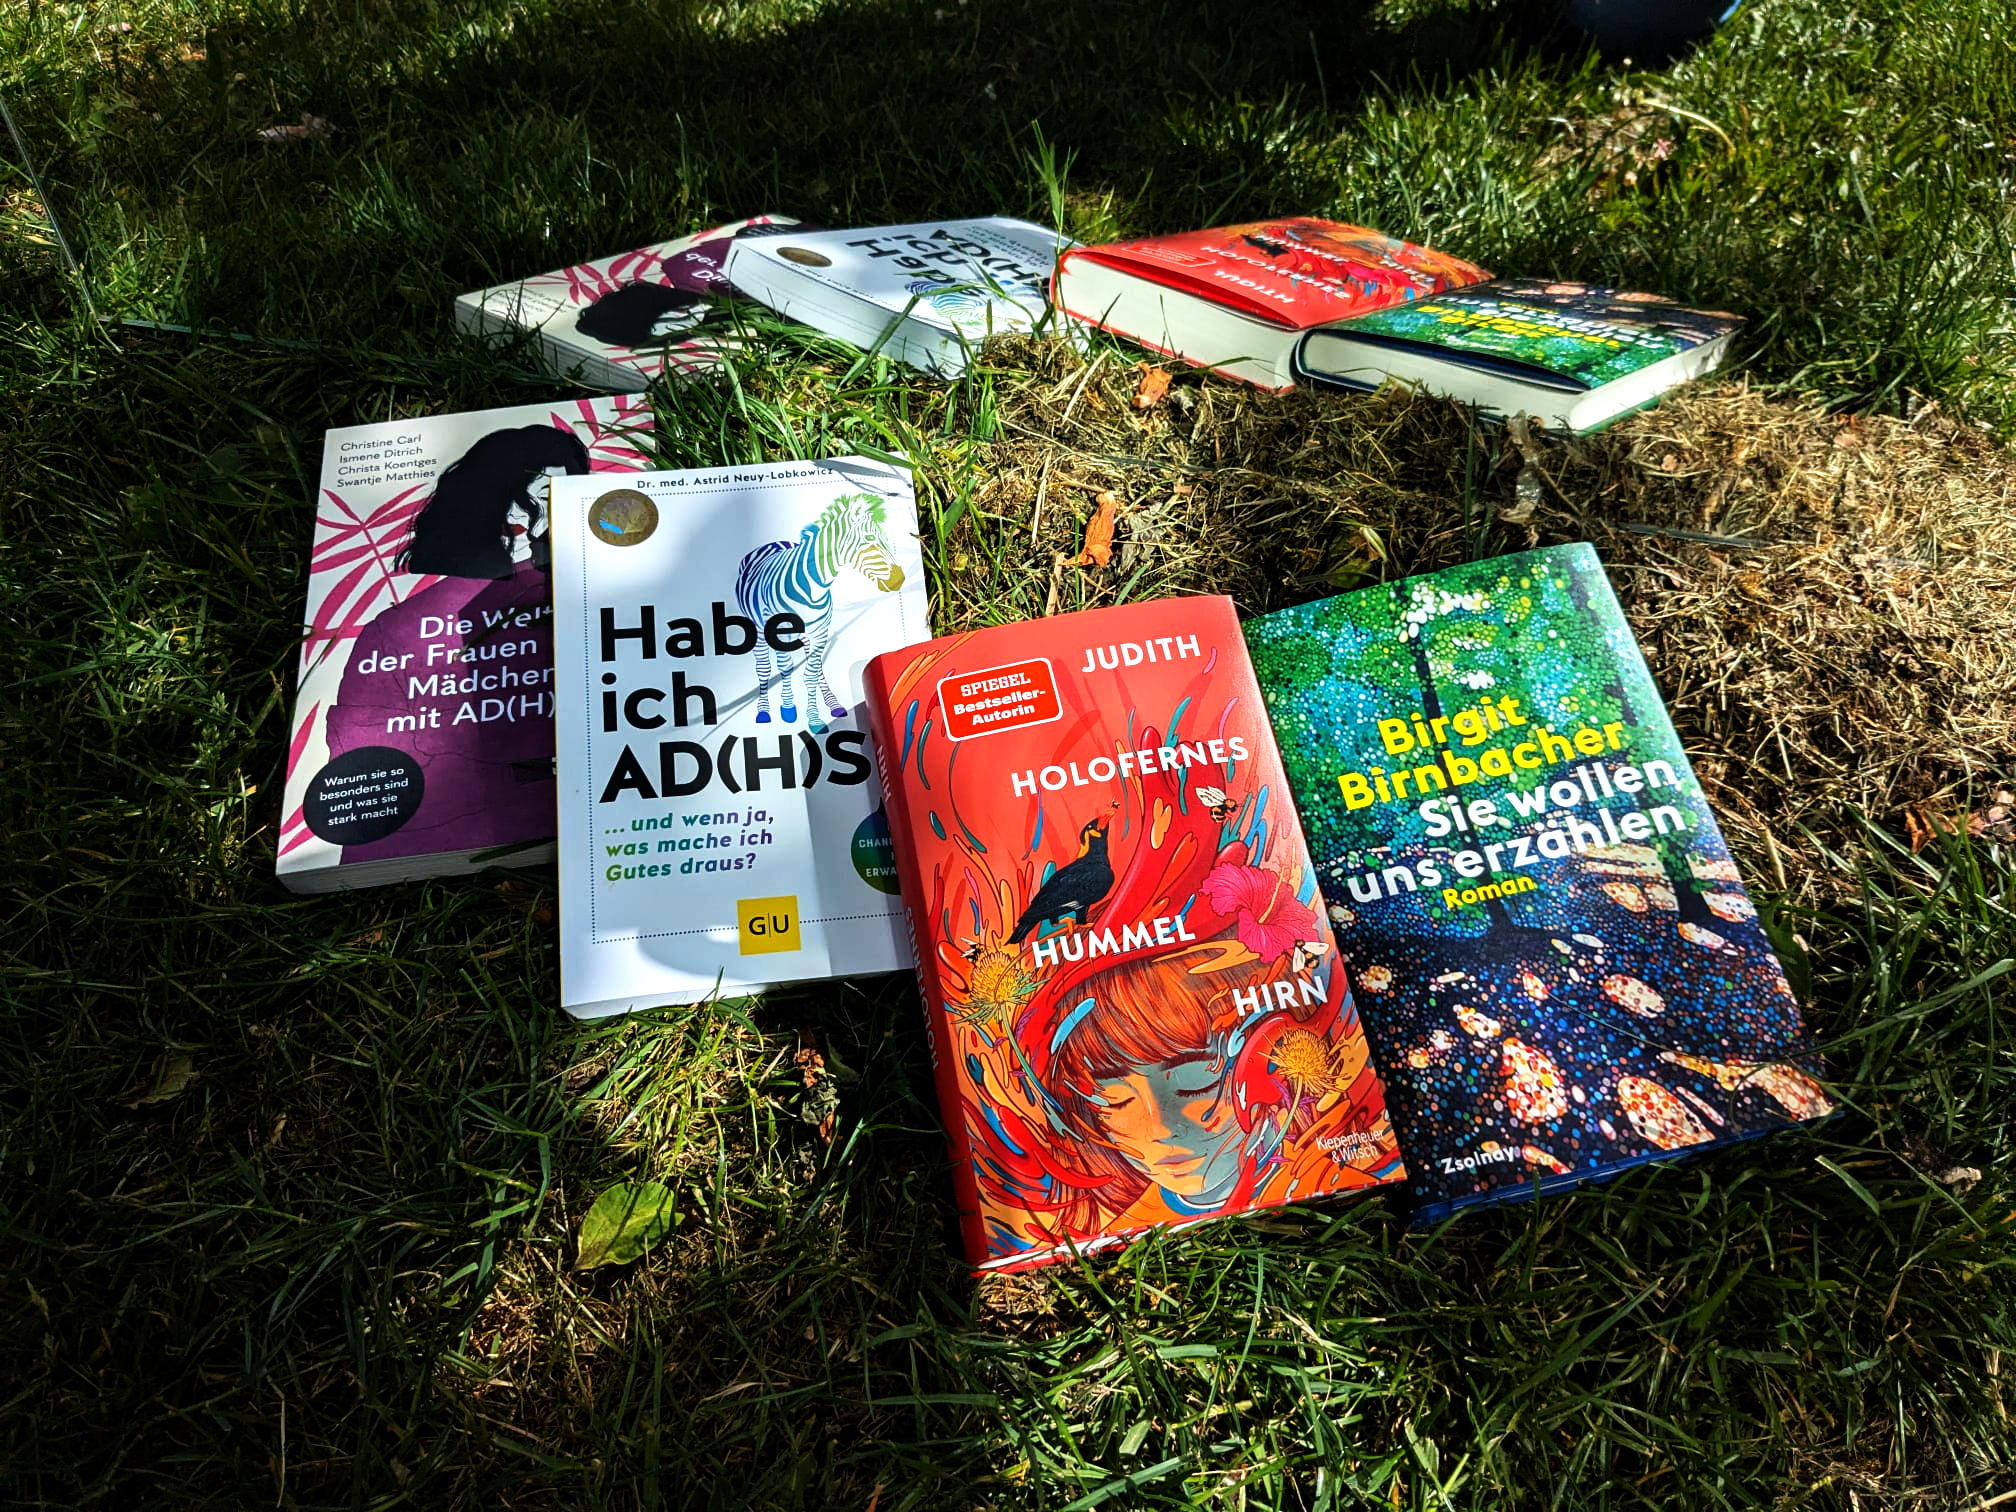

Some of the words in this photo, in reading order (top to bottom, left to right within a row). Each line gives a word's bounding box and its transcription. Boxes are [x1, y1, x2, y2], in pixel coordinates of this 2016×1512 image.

[339, 453, 380, 464] Ismene
[384, 446, 423, 458] Ditrich
[340, 439, 393, 452] Christine
[397, 434, 421, 445] Carl
[337, 475, 382, 488] Swantje
[386, 469, 436, 482] Matthies
[338, 465, 380, 476] Christa
[384, 458, 438, 471] Koentges
[637, 479, 656, 489] Dr.
[660, 476, 689, 488] med.
[693, 474, 729, 486] Astrid
[734, 467, 834, 483] Neuy-Lobkowicz
[419, 614, 473, 639] Die
[600, 601, 806, 663] Habe
[358, 650, 415, 674] der
[427, 639, 537, 667] Frauen
[1081, 634, 1201, 674] JUDITH
[960, 672, 1032, 697] SPIEGEL
[601, 671, 718, 733] ich
[953, 688, 1046, 715] Bestseller-
[971, 703, 1036, 726] Autorin
[386, 706, 441, 733] mit
[1377, 694, 1526, 756] Birgit
[324, 774, 367, 787] Warum
[371, 769, 387, 779] sie
[390, 768, 404, 776] so
[599, 729, 872, 804] AD(H)S
[1011, 736, 1249, 798] HOLOFERNES
[1337, 720, 1624, 811] Birnbacher
[319, 785, 381, 801] besonders
[384, 778, 409, 790] sind
[329, 800, 353, 812] und
[356, 798, 378, 807] was
[381, 793, 398, 804] sie
[1419, 795, 1498, 838] Sie
[1505, 758, 1680, 818] wollen
[328, 812, 358, 826] stark
[361, 806, 399, 820] macht
[631, 812, 673, 832] und
[682, 811, 739, 828] wenn
[742, 806, 774, 827] ja,
[605, 840, 649, 857] was
[657, 833, 732, 853] mache
[740, 828, 773, 847] ich
[1347, 857, 1443, 903] uns
[1453, 804, 1687, 878] erzählen
[606, 862, 672, 882] Gutes
[680, 852, 757, 875] draus?
[1442, 876, 1535, 909] Roman
[1031, 915, 1196, 969] HUMMEL
[1231, 975, 1328, 1017] HIRN
[1315, 1128, 1385, 1151] Kiepenheuer
[1441, 1145, 1516, 1175] Zsolnay
